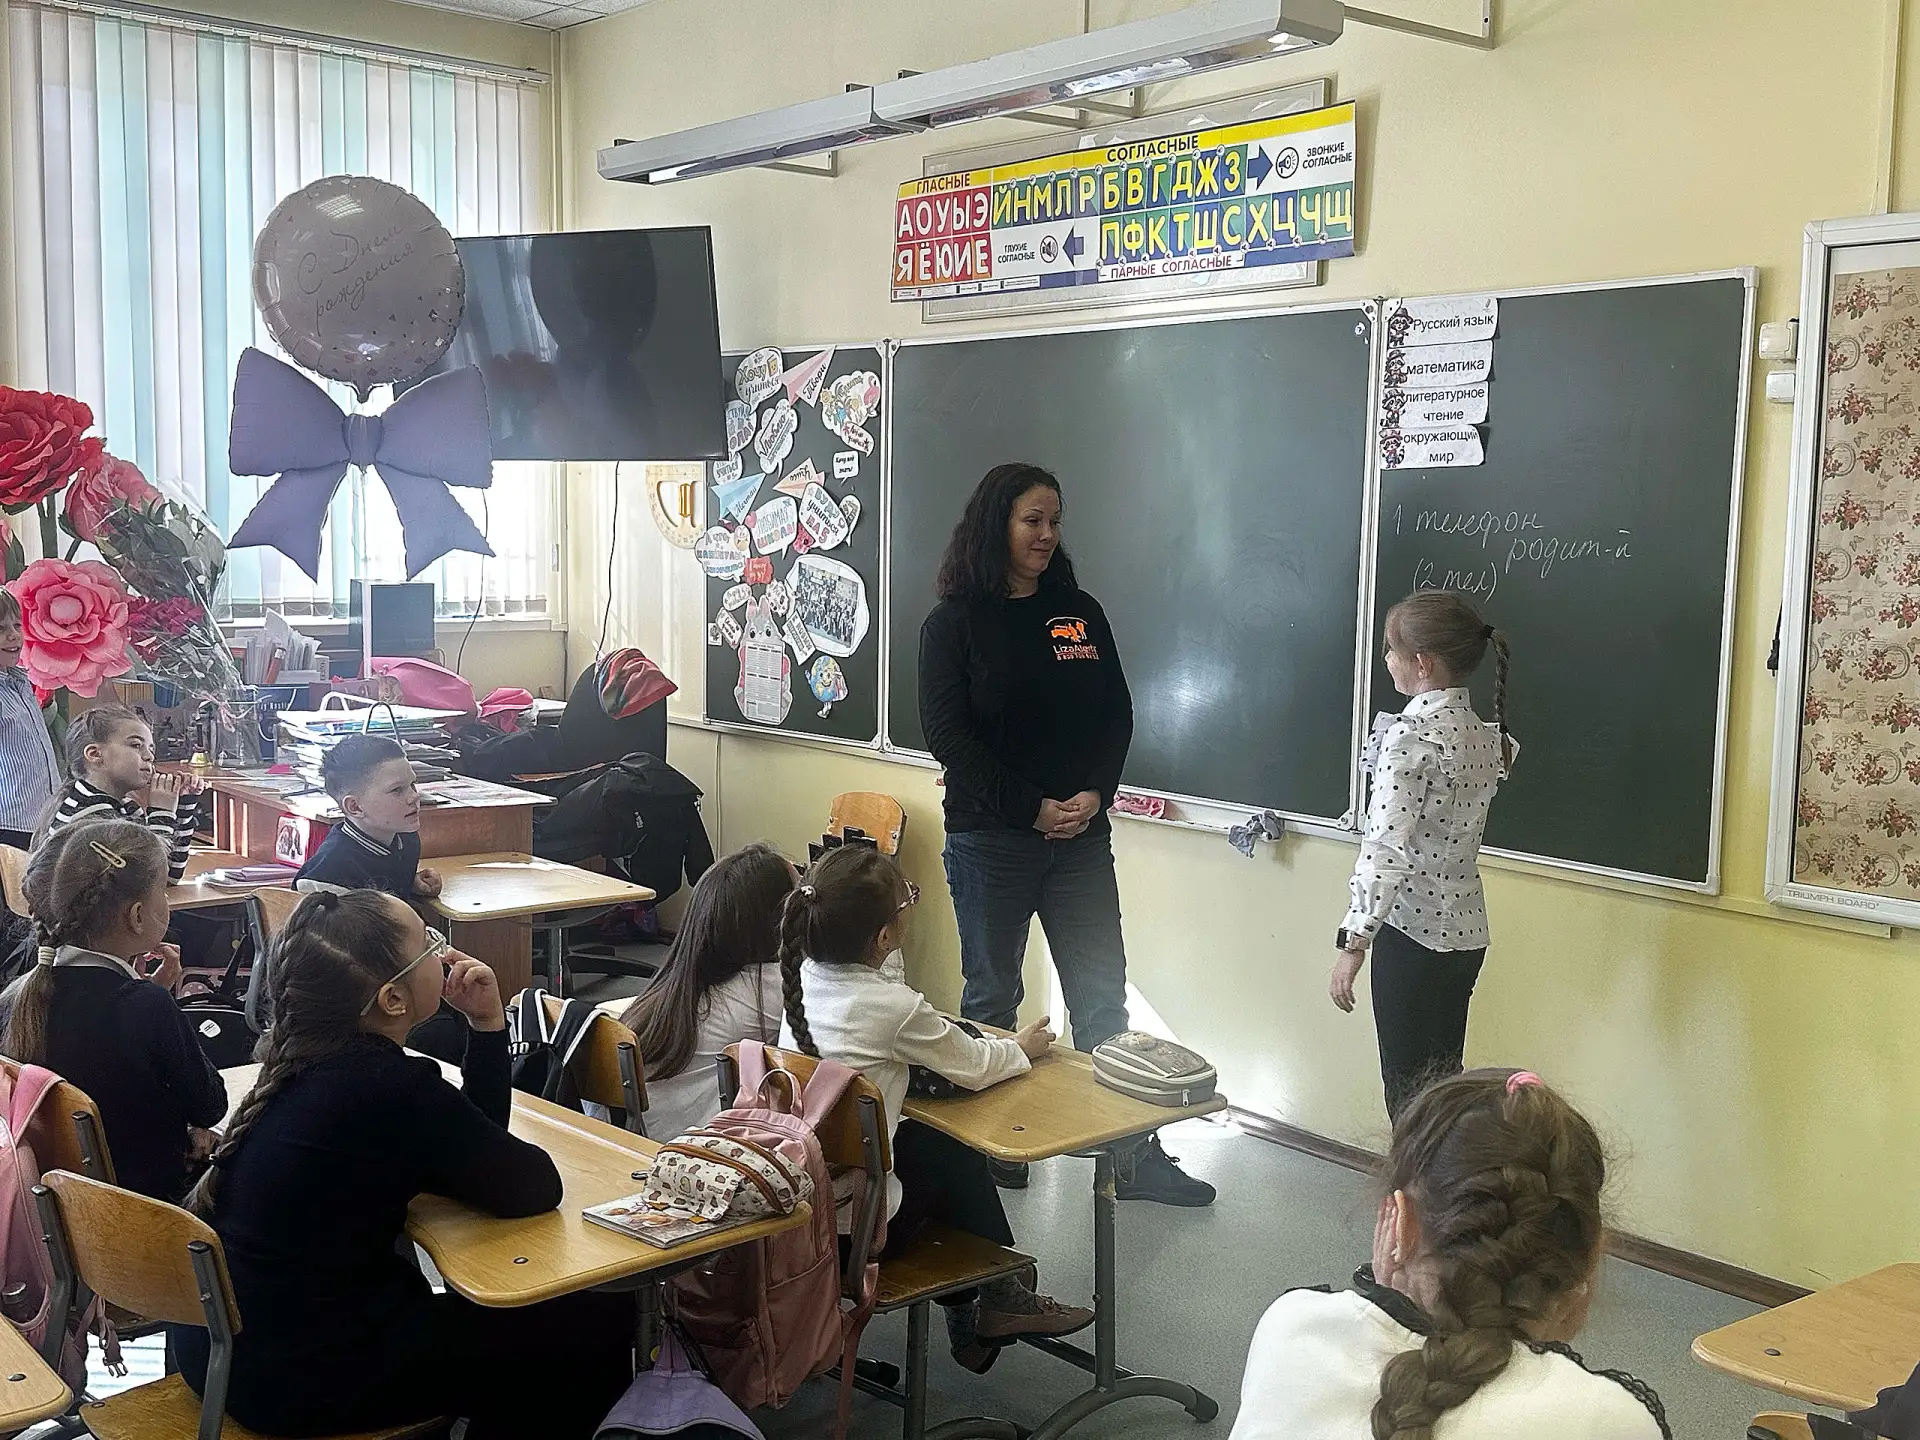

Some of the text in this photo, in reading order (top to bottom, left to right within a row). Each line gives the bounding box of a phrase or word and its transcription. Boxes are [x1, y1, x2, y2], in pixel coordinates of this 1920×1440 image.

[1107, 135, 1199, 162] СОГЛАСНЫЕ
[1306, 142, 1345, 156] ЗВОНКИЕ
[1302, 152, 1353, 169] СОГЛАСНЫЕ
[916, 173, 971, 194] ГЛАСНЫЕ
[1004, 243, 1028, 253] ГЛУХИЕ
[997, 251, 1036, 264] СОГЛАСНЫЕ
[1110, 254, 1232, 279] ПАРНЫЕ СОГЛАСНЫЕ
[1413, 314, 1494, 333] Русский язык
[1406, 359, 1485, 375] математика
[1406, 388, 1485, 403] литературное
[1423, 410, 1464, 421] чтение
[1429, 451, 1454, 464] мир
[1394, 504, 1545, 549] 1 телефон
[1787, 889, 1876, 910] TRIUMPH BOARD
